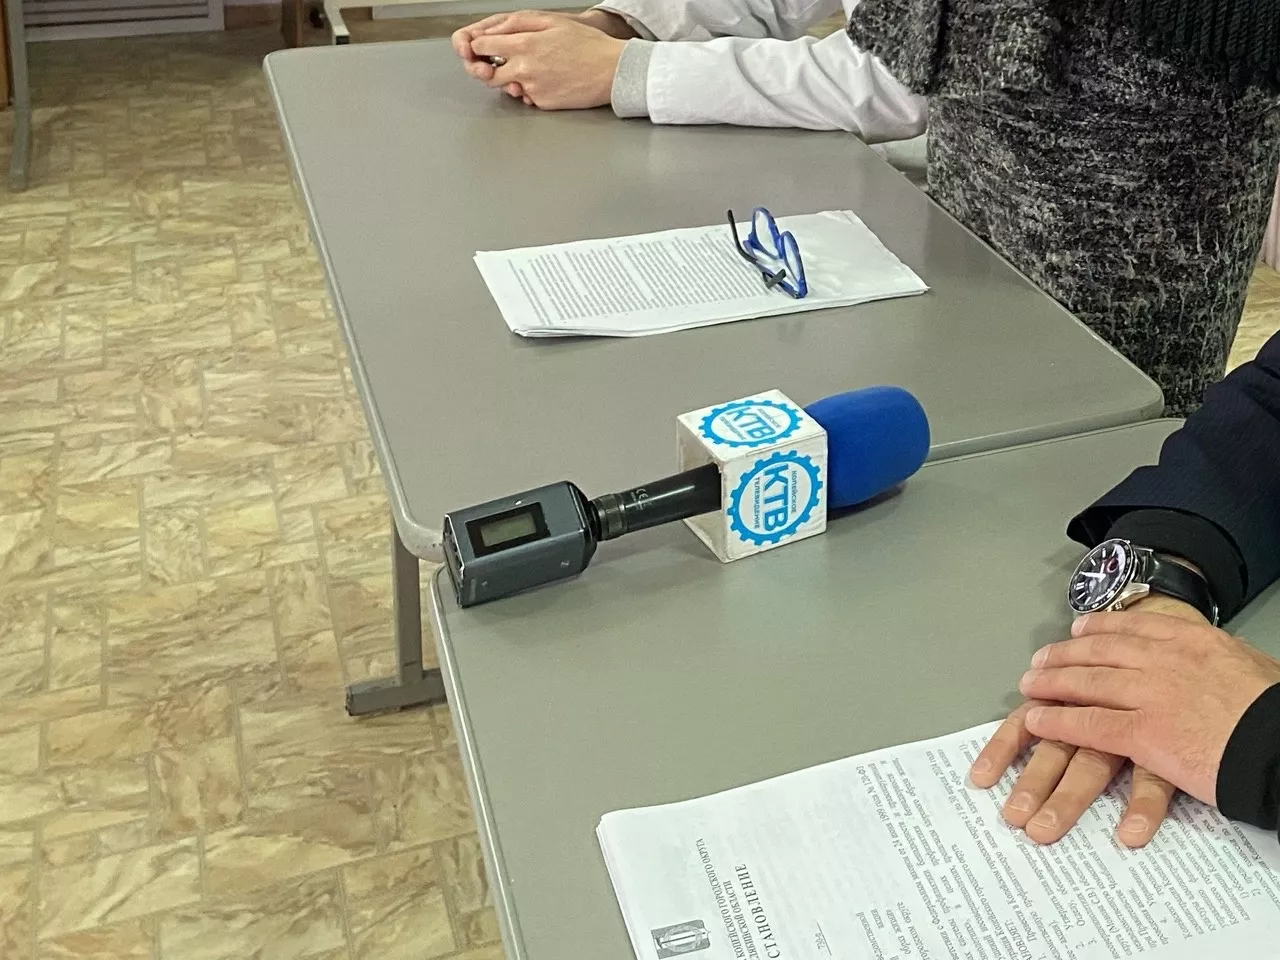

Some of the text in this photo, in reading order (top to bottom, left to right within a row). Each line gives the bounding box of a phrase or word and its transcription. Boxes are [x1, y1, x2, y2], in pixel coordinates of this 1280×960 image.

[725, 406, 777, 439] КТВ
[753, 476, 762, 530] ТЕЛЕВИДЕНИЕ
[763, 463, 790, 532] КТВ
[791, 469, 799, 514] КОПЕЙСКОЕ
[876, 808, 889, 821] 1999
[696, 838, 744, 958] КОПЕЙСКОГО ГОРОДСКОГО ОКРУГА
[723, 880, 741, 913] ОБЛАСТИ
[735, 863, 780, 959] СТАНОВЛЕНИЕ
